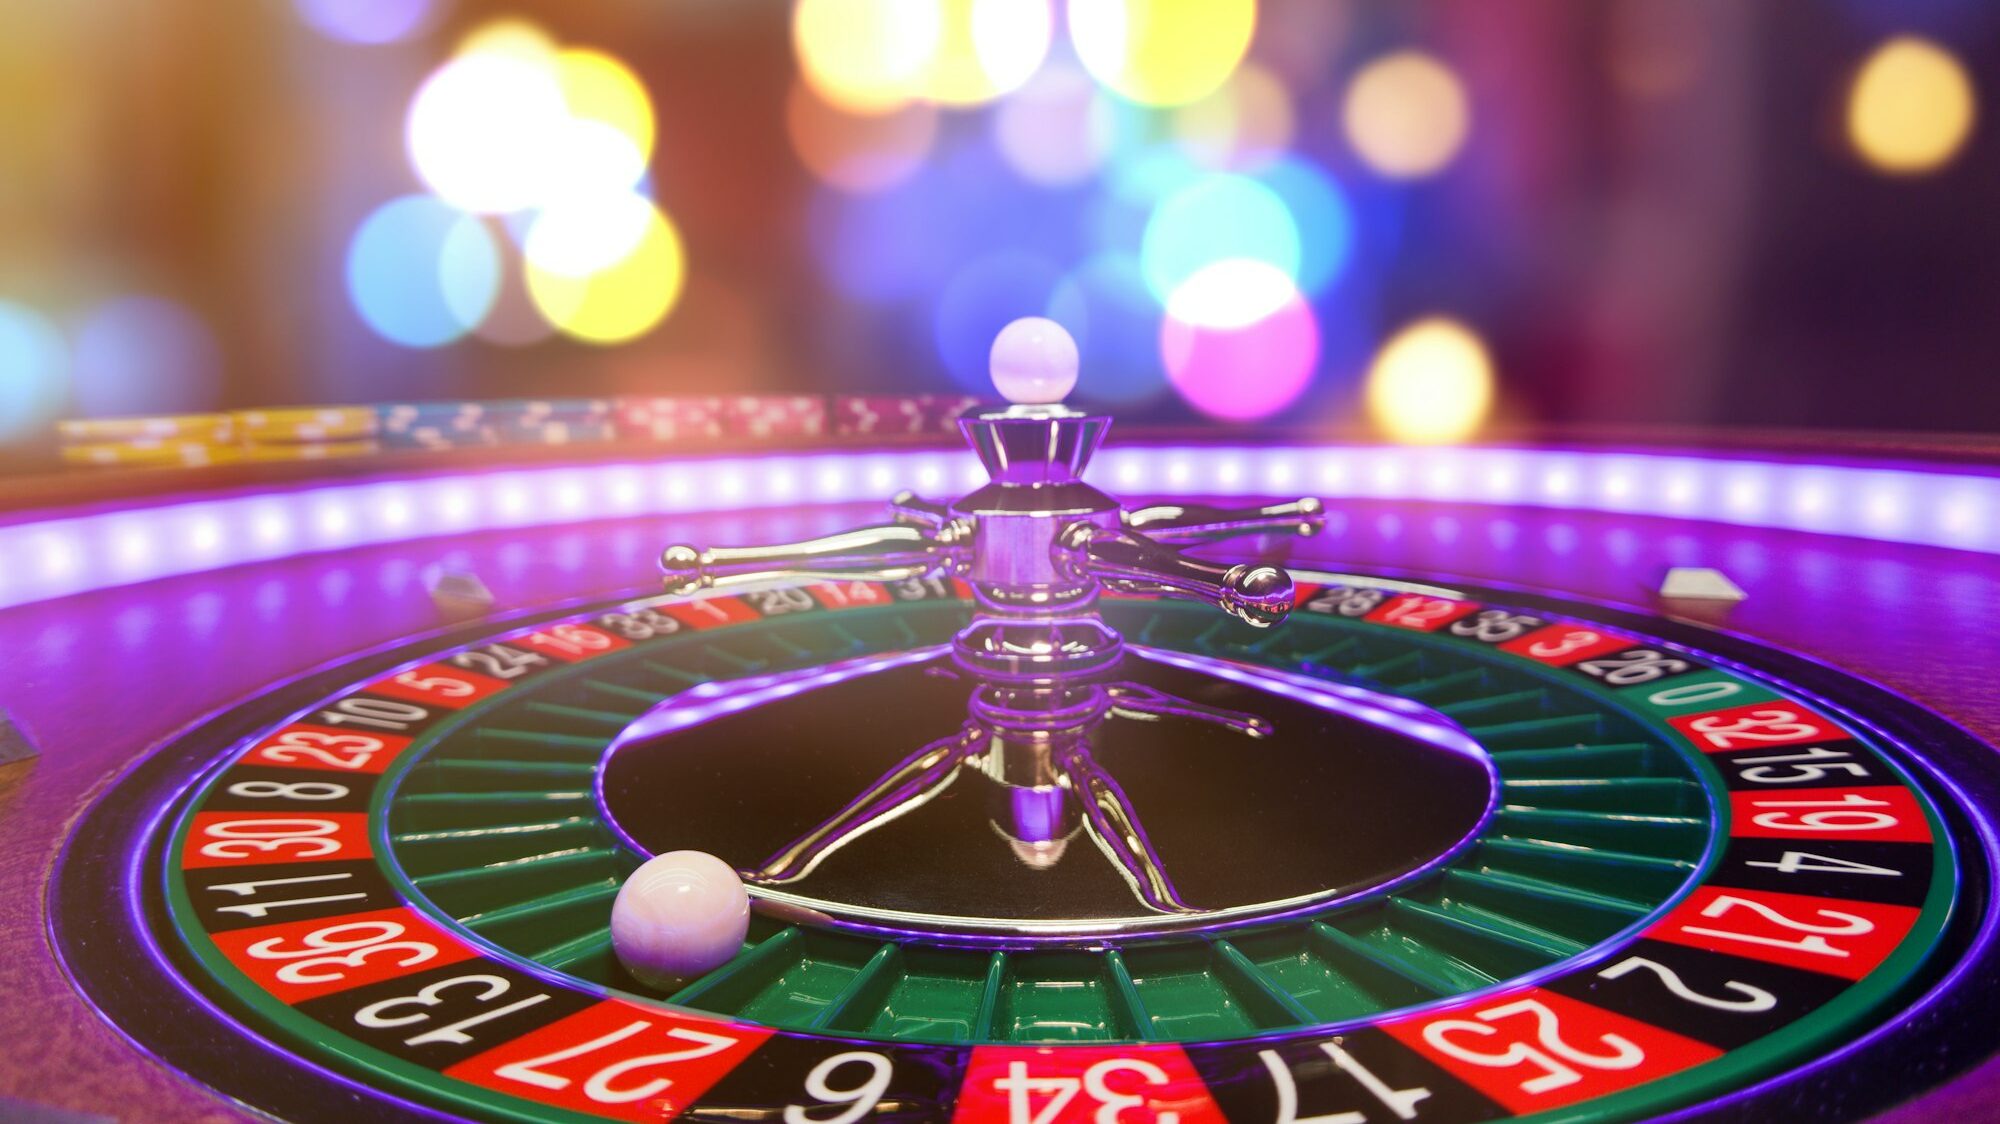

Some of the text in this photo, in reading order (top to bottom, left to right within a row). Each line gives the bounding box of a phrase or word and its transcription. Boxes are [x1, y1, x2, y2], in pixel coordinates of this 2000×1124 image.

[823, 581, 877, 606] 14
[898, 567, 946, 600] 31
[692, 599, 728, 622] 1
[751, 588, 814, 616] 20
[1309, 586, 1384, 616] 28
[1384, 596, 1455, 627] 12
[530, 623, 612, 654] 16
[602, 610, 679, 639] 33
[1451, 610, 1541, 641] 35
[453, 644, 548, 679] 24
[1529, 632, 1600, 657] 3
[395, 671, 475, 697] 5
[1578, 650, 1689, 684] 26
[1648, 682, 1742, 705] 0
[321, 698, 428, 730] 10
[1690, 710, 1819, 748] 32
[261, 731, 384, 769] 23
[1731, 748, 1870, 783] 15
[227, 781, 349, 800] 8
[1751, 794, 1898, 831] 19
[200, 818, 342, 858] 30
[1745, 851, 1903, 876] 4
[206, 872, 368, 918] 11
[1681, 895, 1875, 957] 21
[246, 920, 439, 984] 36
[1597, 955, 1777, 1012] 2
[353, 974, 551, 1047] 13
[493, 1020, 740, 1104] 27
[1422, 998, 1645, 1094] 25
[993, 1058, 1178, 1124] 34
[1258, 1042, 1432, 1124] 17
